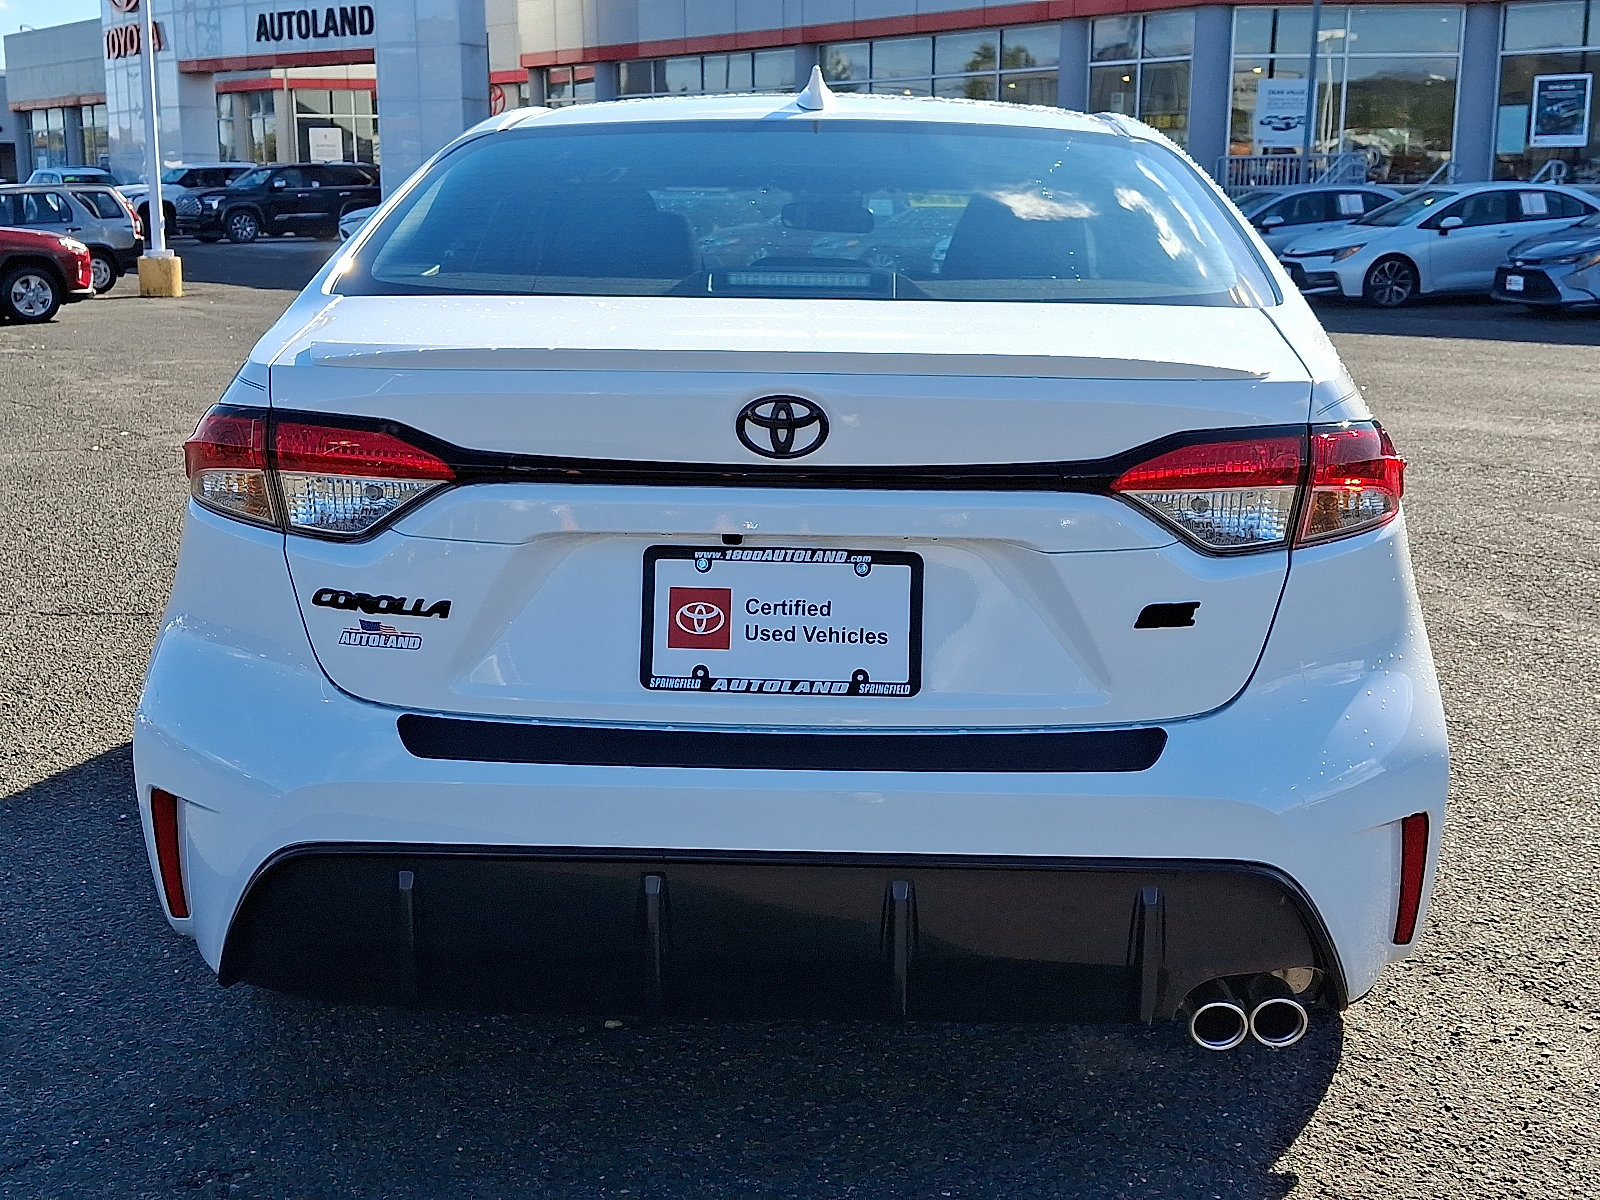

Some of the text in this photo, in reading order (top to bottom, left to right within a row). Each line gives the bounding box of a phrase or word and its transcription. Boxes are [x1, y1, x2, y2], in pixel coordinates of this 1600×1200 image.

[256, 5, 374, 42] AUTOLAND
[103, 21, 164, 59] TOYOA
[312, 587, 452, 619] COROLLA
[745, 598, 832, 617] Certified
[340, 631, 422, 650] AUTOLAND
[745, 624, 889, 645] Used Vehicles
[649, 677, 911, 695] SPRINGFIELD AUTOLAND SPRINGFIELD
